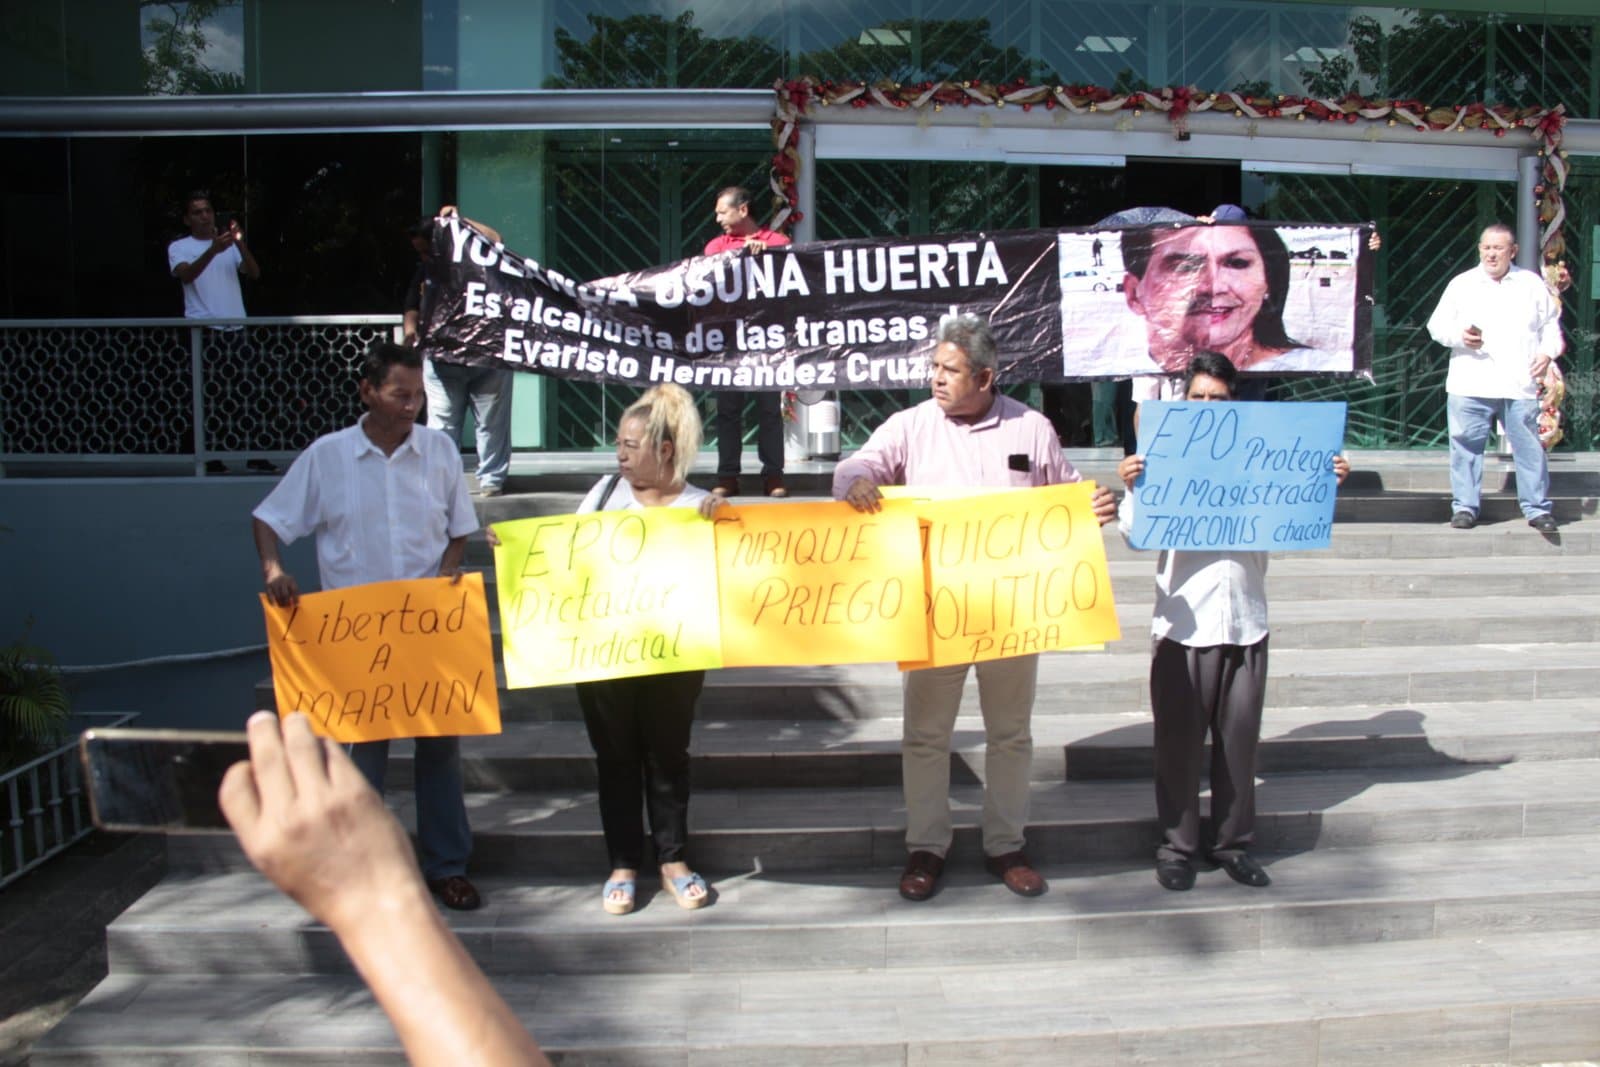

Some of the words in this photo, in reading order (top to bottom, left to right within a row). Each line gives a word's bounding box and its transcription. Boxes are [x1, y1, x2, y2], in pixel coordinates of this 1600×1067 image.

[655, 253, 810, 308] OSUNA
[824, 241, 1008, 294] HUERTA
[465, 282, 502, 318] Es
[511, 296, 673, 351] alcahueta
[685, 322, 724, 353] de
[736, 318, 786, 351] las
[795, 315, 928, 347] transas
[503, 328, 639, 379] Evaristo
[1145, 407, 1239, 461] EPO
[1244, 436, 1337, 481] Protege
[1140, 477, 1173, 507] al
[1179, 475, 1328, 508] Magistrado
[521, 514, 646, 578] EPO
[716, 518, 878, 567] NRIQUE
[1142, 514, 1261, 547] TRACONIS
[281, 591, 468, 644] Libertad
[512, 576, 676, 630] Dictador
[751, 577, 903, 626] PRIEGO
[369, 642, 392, 673] A
[556, 622, 682, 673] Judicial
[969, 624, 1060, 664] PARA
